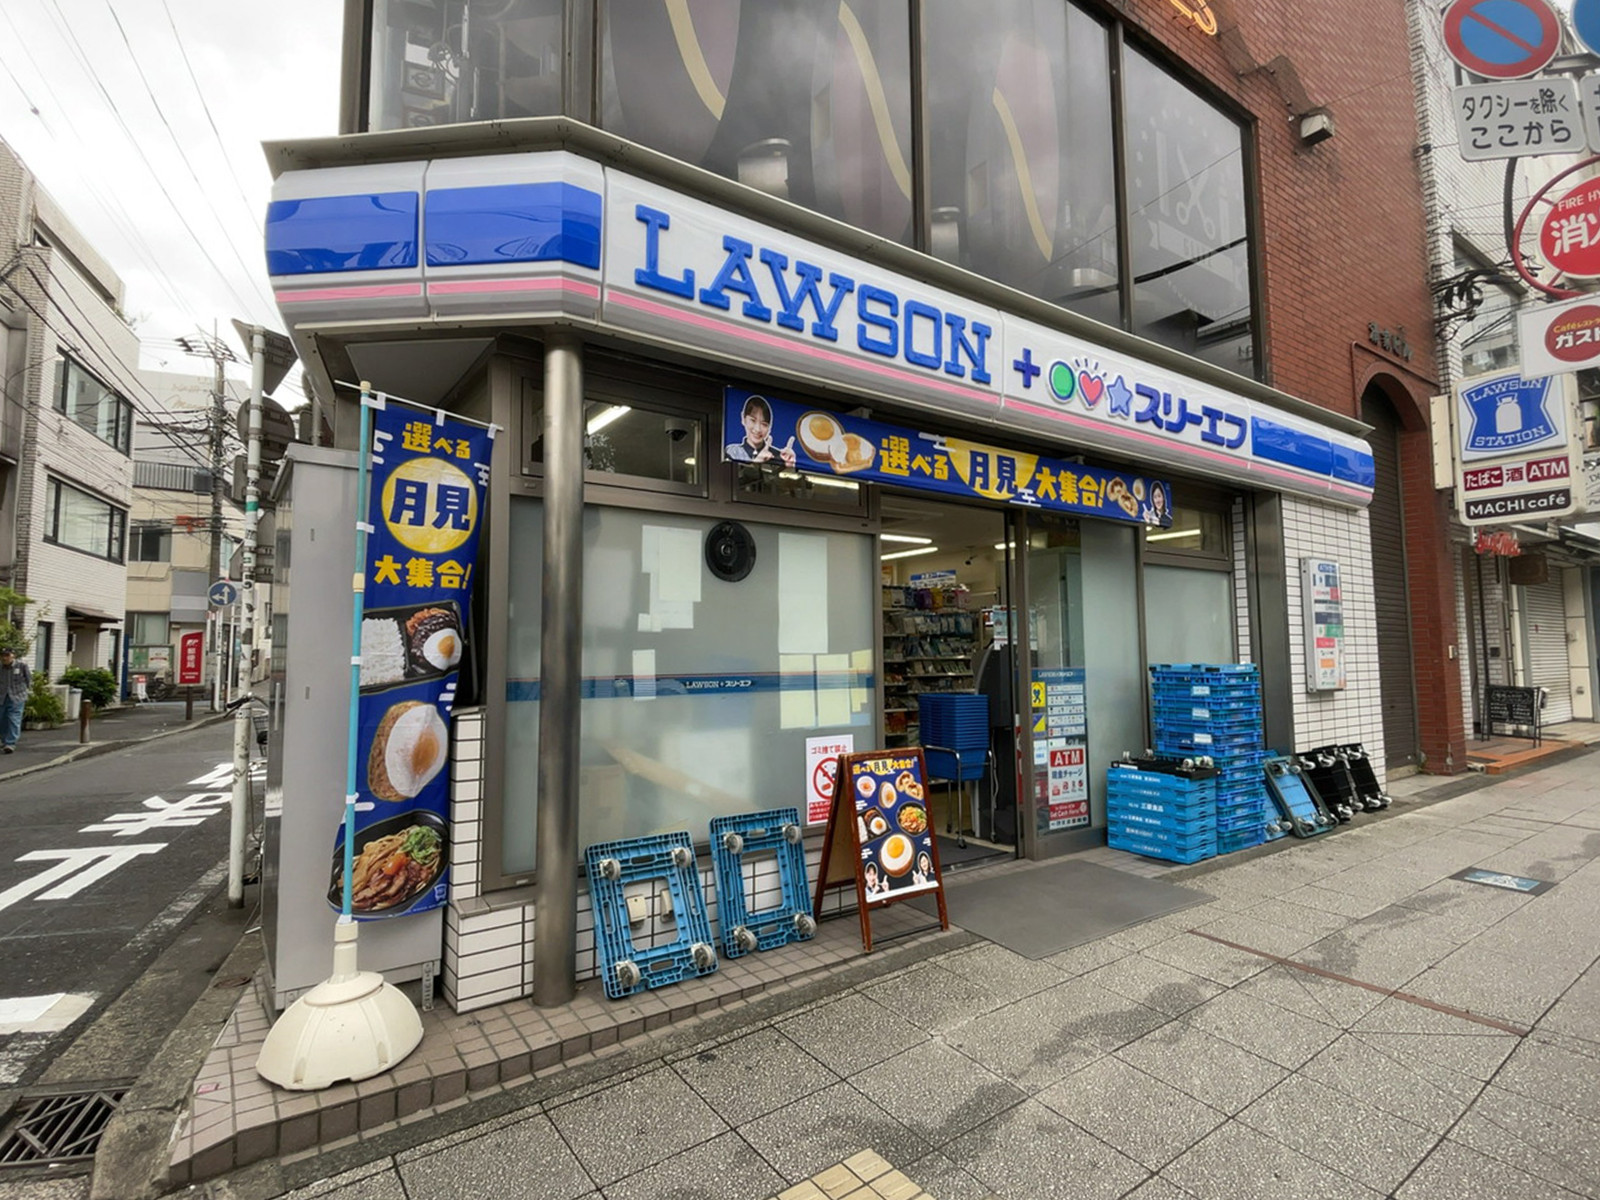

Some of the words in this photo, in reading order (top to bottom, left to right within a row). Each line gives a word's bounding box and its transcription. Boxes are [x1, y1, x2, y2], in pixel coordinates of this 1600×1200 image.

[1462, 88, 1569, 121] タクシーを除く
[1471, 119, 1572, 149] ここから
[1557, 194, 1584, 212] FIRE
[635, 203, 991, 384] LAWSON
[1134, 382, 1248, 450] スリーエフ
[1470, 377, 1545, 402] LAWSON
[402, 420, 471, 459] 選べる
[1474, 425, 1547, 447] STATION
[1465, 469, 1502, 489] たばこ
[1528, 460, 1567, 479] ATM
[388, 477, 471, 531] 月見
[1469, 499, 1525, 517] MACHI
[1527, 493, 1566, 509] café
[374, 554, 472, 589] 大集合!
[1054, 750, 1081, 766] ATM
